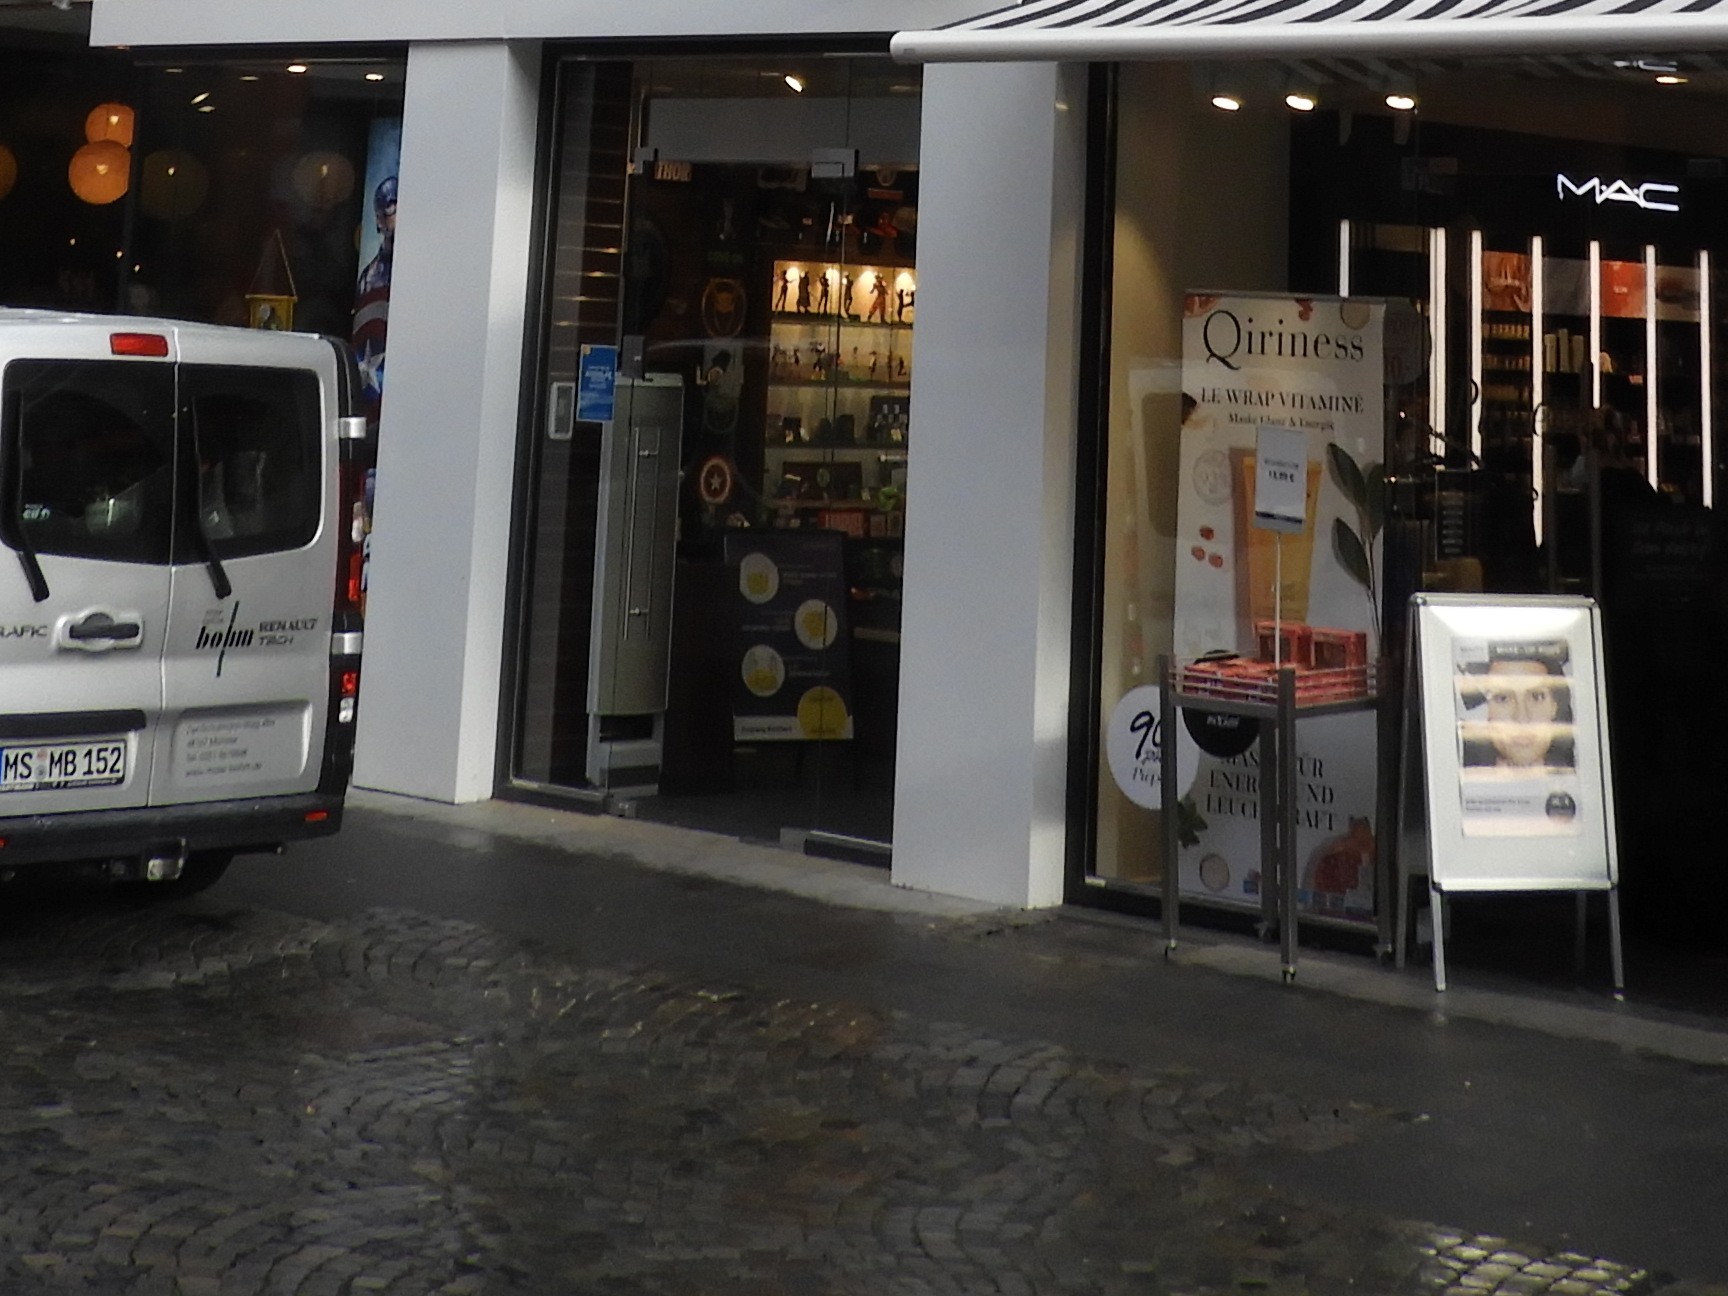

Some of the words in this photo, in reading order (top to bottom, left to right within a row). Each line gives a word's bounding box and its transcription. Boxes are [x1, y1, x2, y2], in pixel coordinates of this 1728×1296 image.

[1203, 309, 1364, 369] Qiriness
[1200, 386, 1222, 405] LE
[1225, 387, 1275, 408] WRAP
[258, 616, 319, 633] RENAULT
[3, 751, 33, 783] MS
[48, 748, 77, 779] MB
[82, 746, 123, 776] 152
